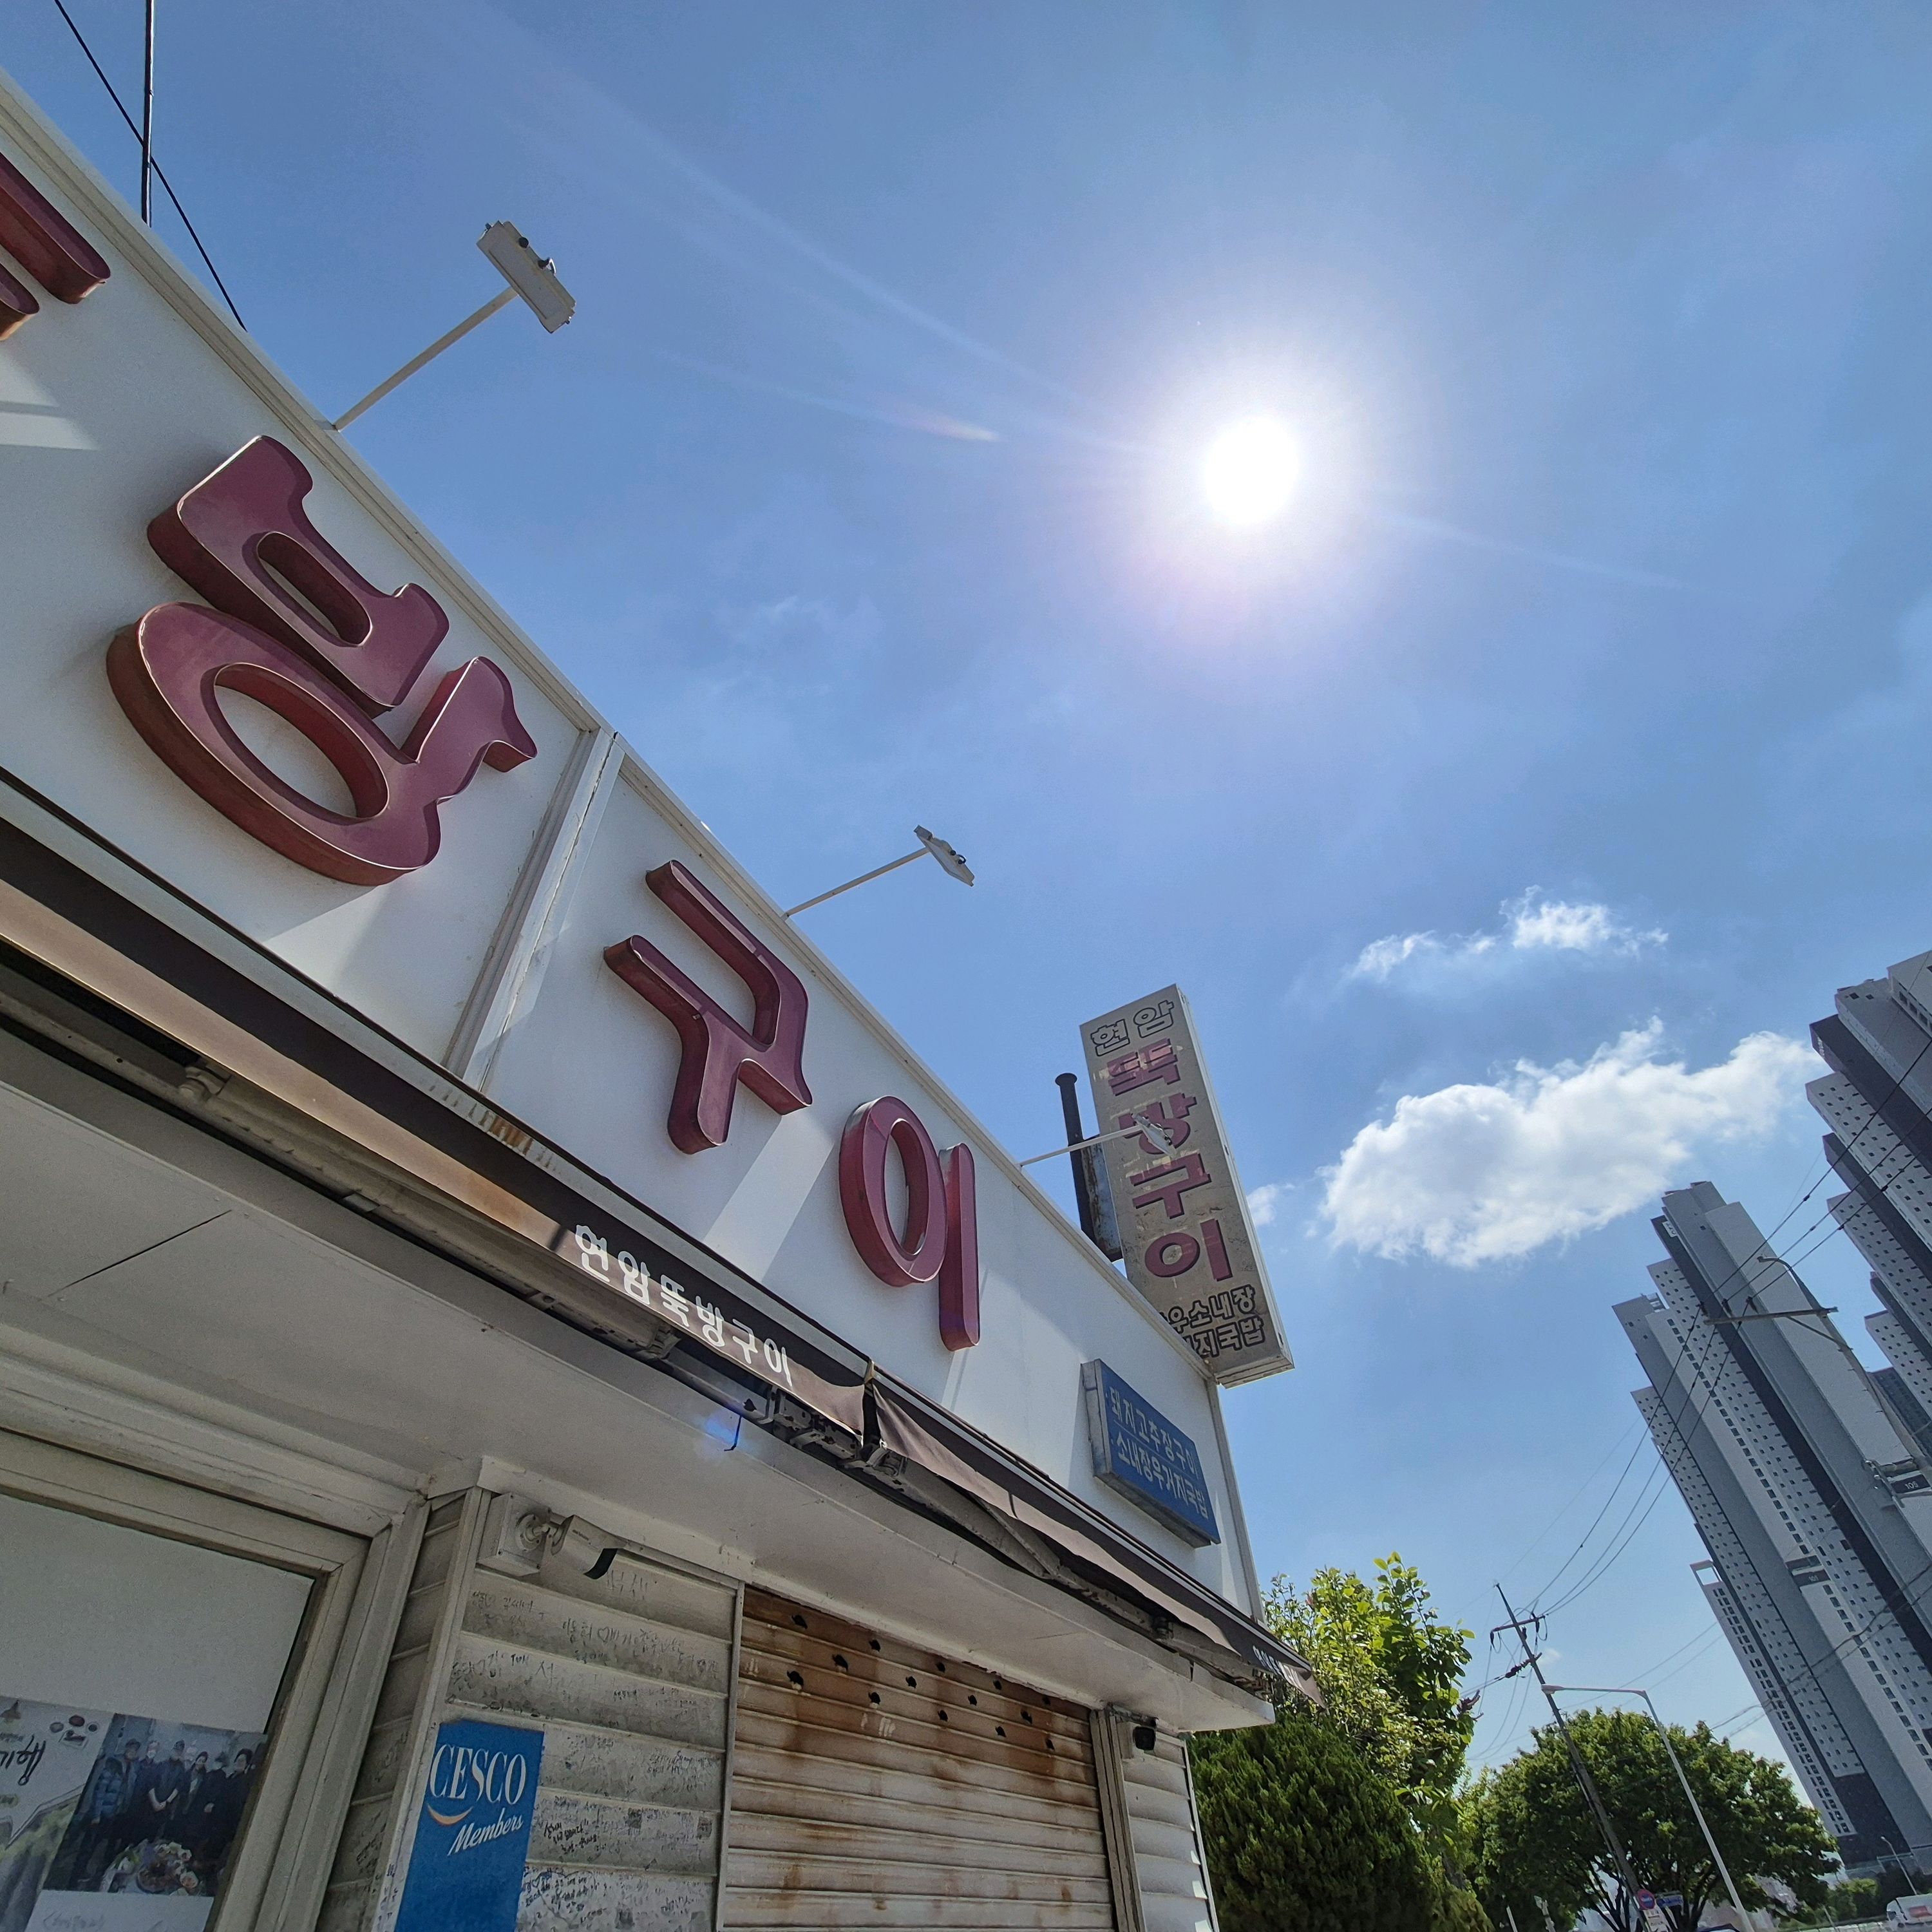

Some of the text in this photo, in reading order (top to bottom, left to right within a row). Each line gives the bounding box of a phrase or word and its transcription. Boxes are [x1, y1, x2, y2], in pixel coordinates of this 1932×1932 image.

[1090, 999, 1175, 1057] 현암
[1160, 1284, 1255, 1334] 우소내장
[1183, 1315, 1265, 1358] 지국밥
[429, 1743, 527, 1805] CESCO
[447, 1807, 524, 1856] Members
